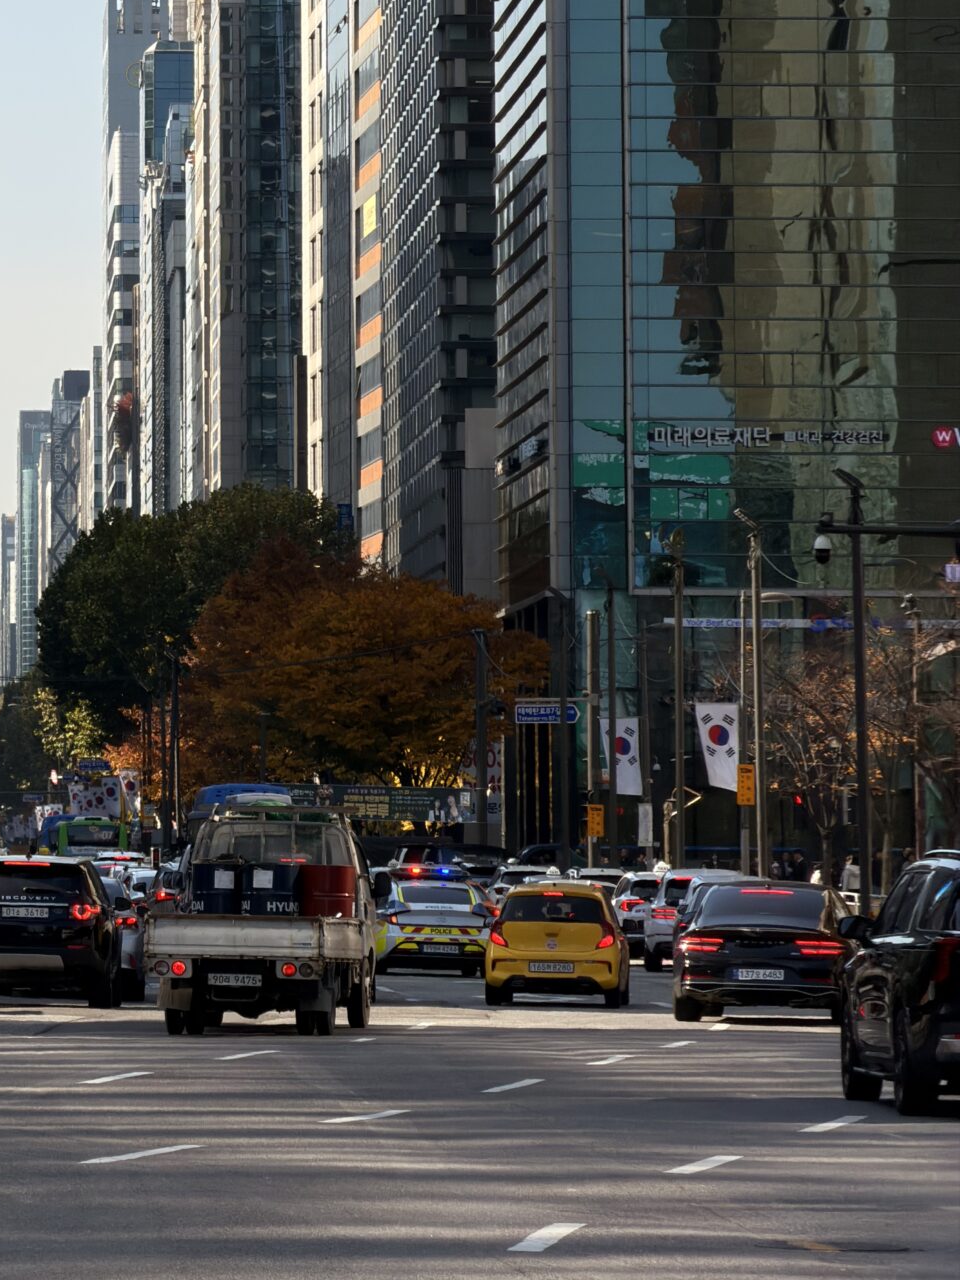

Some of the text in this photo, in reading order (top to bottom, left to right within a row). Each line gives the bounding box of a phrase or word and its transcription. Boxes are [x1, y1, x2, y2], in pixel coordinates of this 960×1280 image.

[653, 425, 772, 448] 미래의료재단
[830, 429, 884, 445] 건강검진
[234, 975, 258, 985] 9475
